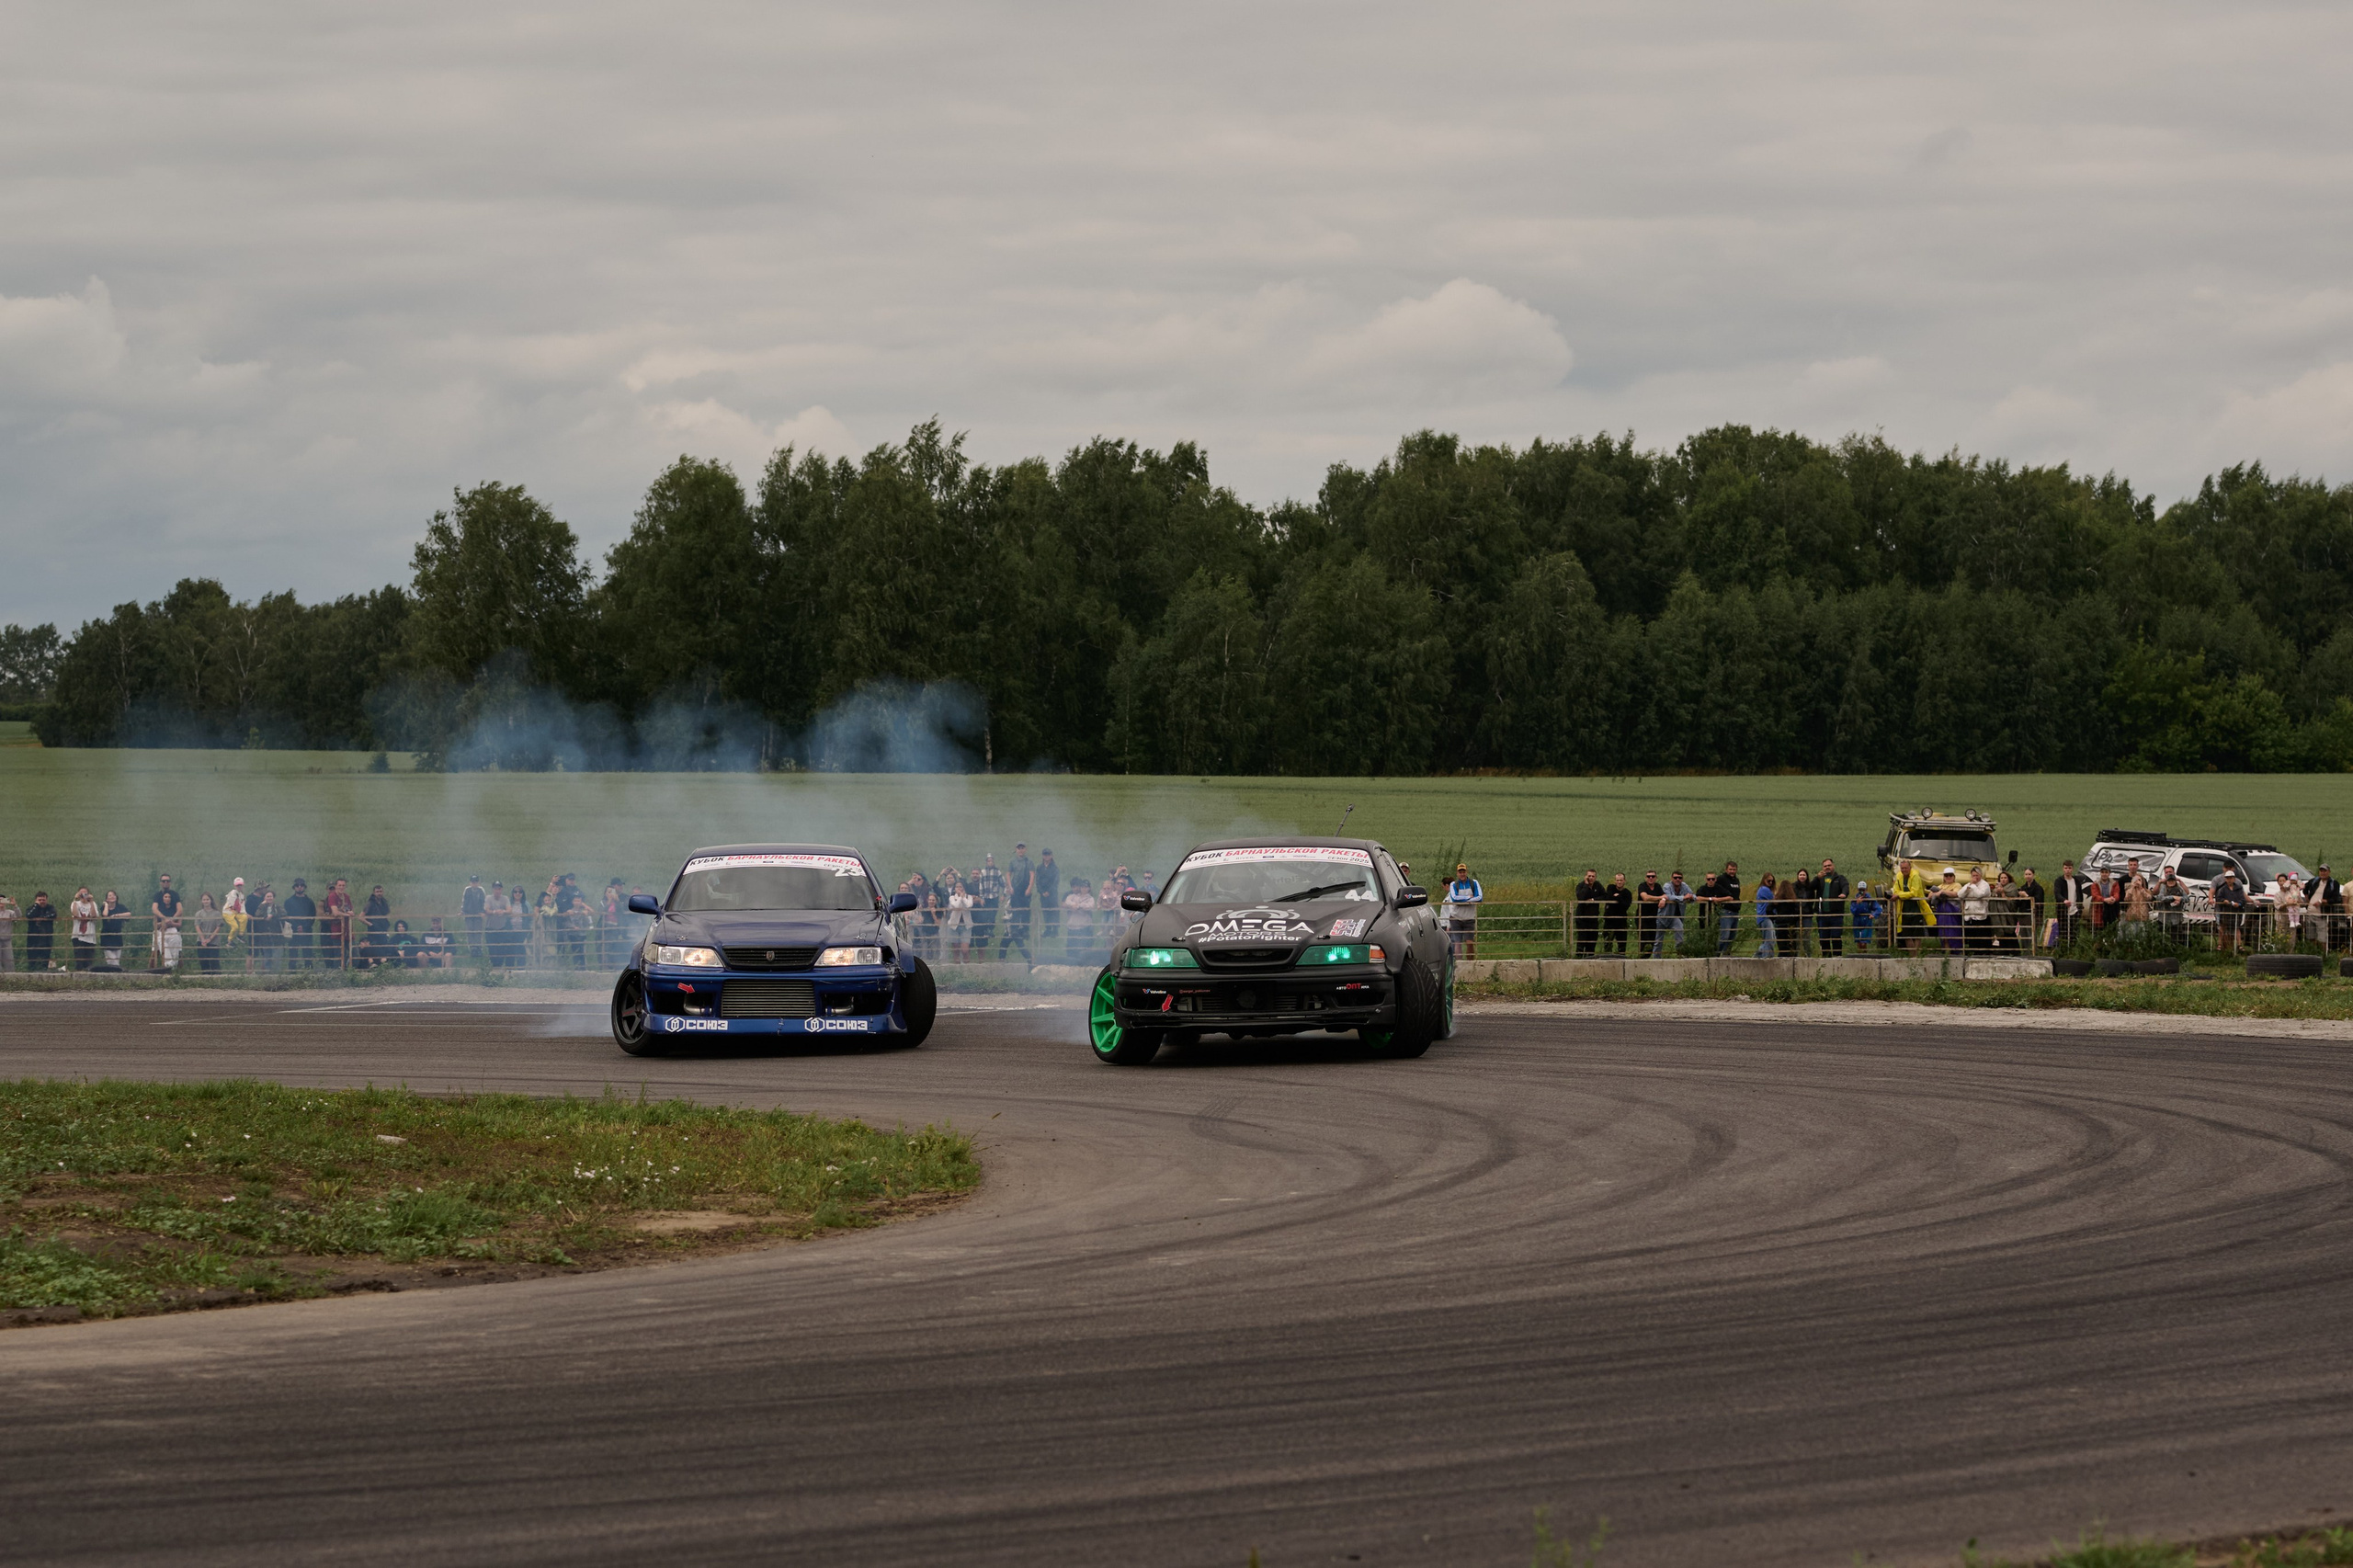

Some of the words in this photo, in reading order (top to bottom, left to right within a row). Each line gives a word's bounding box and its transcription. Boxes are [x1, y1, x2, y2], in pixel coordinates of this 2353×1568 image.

[1186, 852, 1223, 863] КУБОК
[1225, 847, 1318, 857] БАРНАУЛЬСКОЙ
[1321, 848, 1369, 858] РАКЕТЫ
[689, 856, 725, 867] КУБОК
[817, 856, 860, 867] РАКЕТЫ
[1345, 890, 1378, 902] 44
[1185, 919, 1314, 936] OMEGA
[1198, 935, 1302, 943] #PotatoFighter
[686, 1019, 729, 1030] СОЮЗ
[825, 1019, 868, 1030] СОЮЗ
